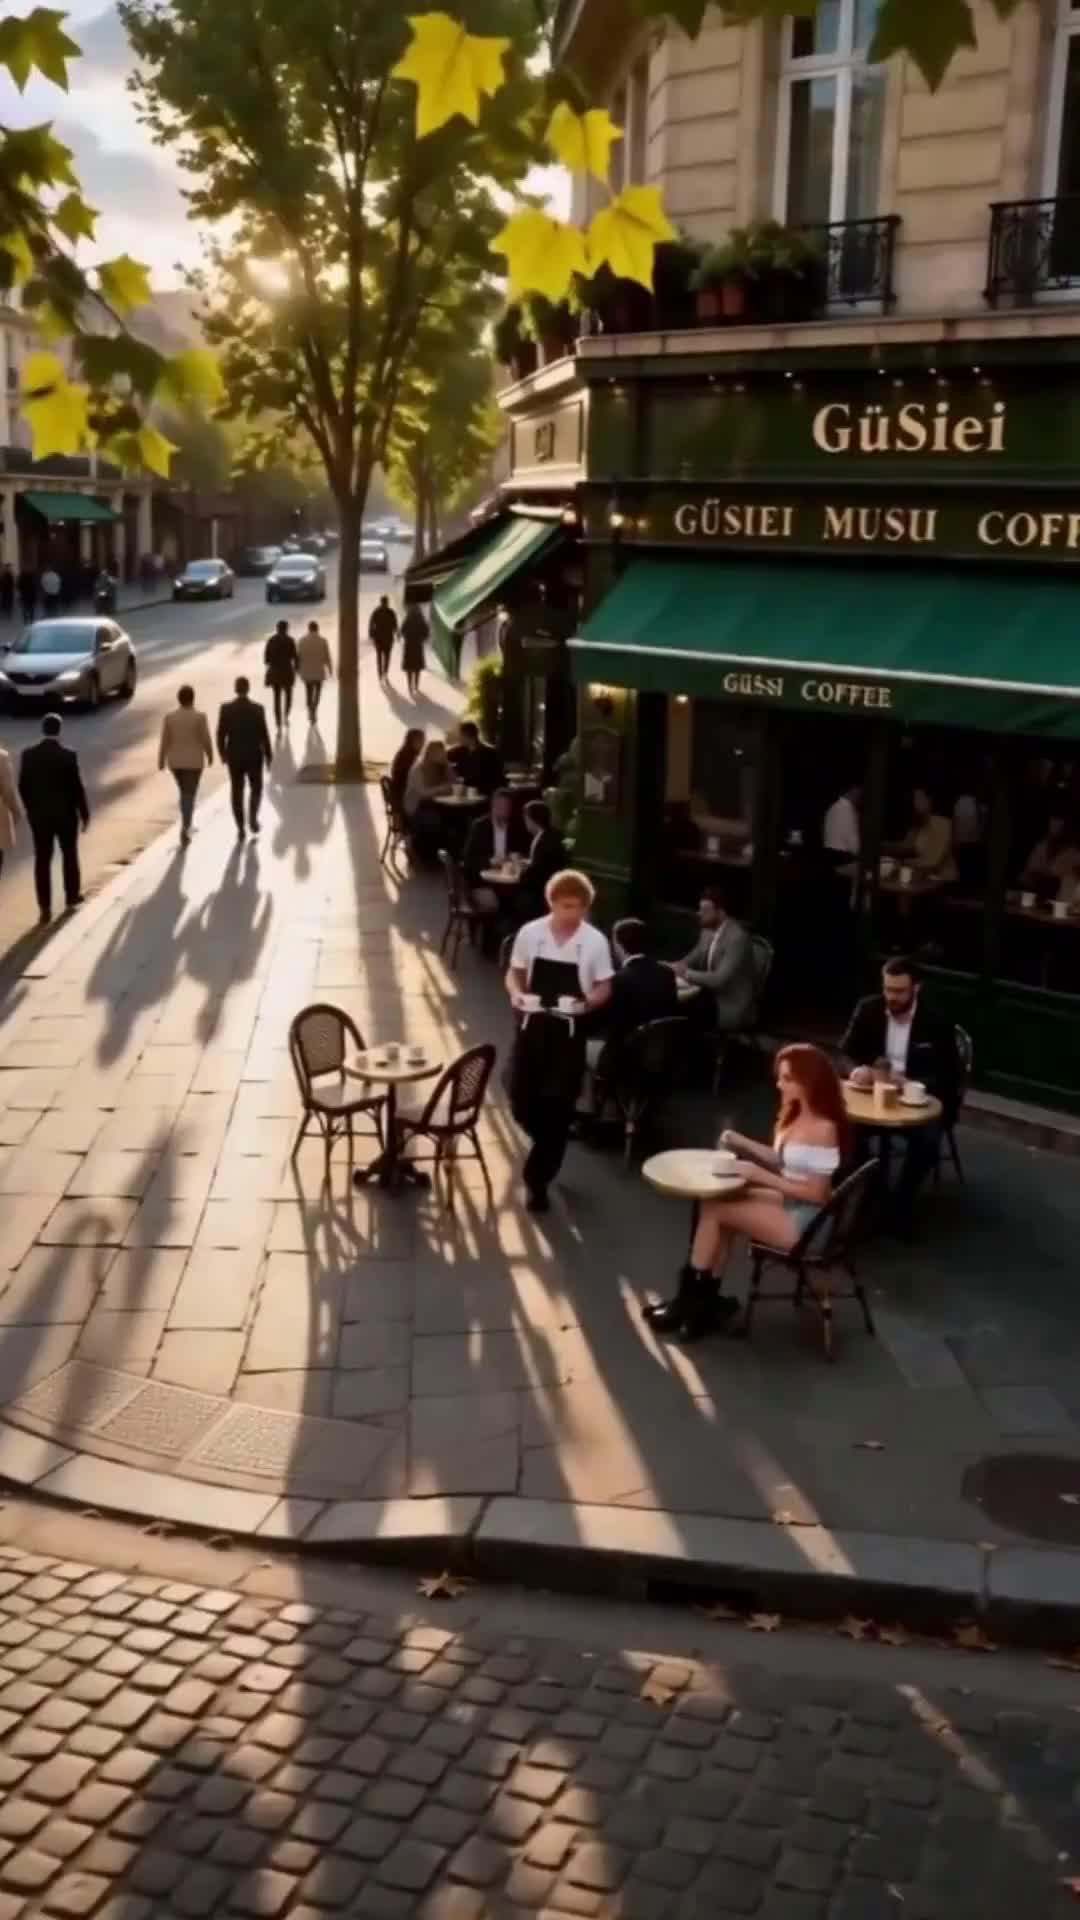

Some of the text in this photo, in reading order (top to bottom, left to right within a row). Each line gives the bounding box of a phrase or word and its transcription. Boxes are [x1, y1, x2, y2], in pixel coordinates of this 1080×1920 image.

[812, 402, 1006, 453] GüSiei
[822, 505, 939, 541] MUSU
[801, 680, 892, 708] COFFEE
